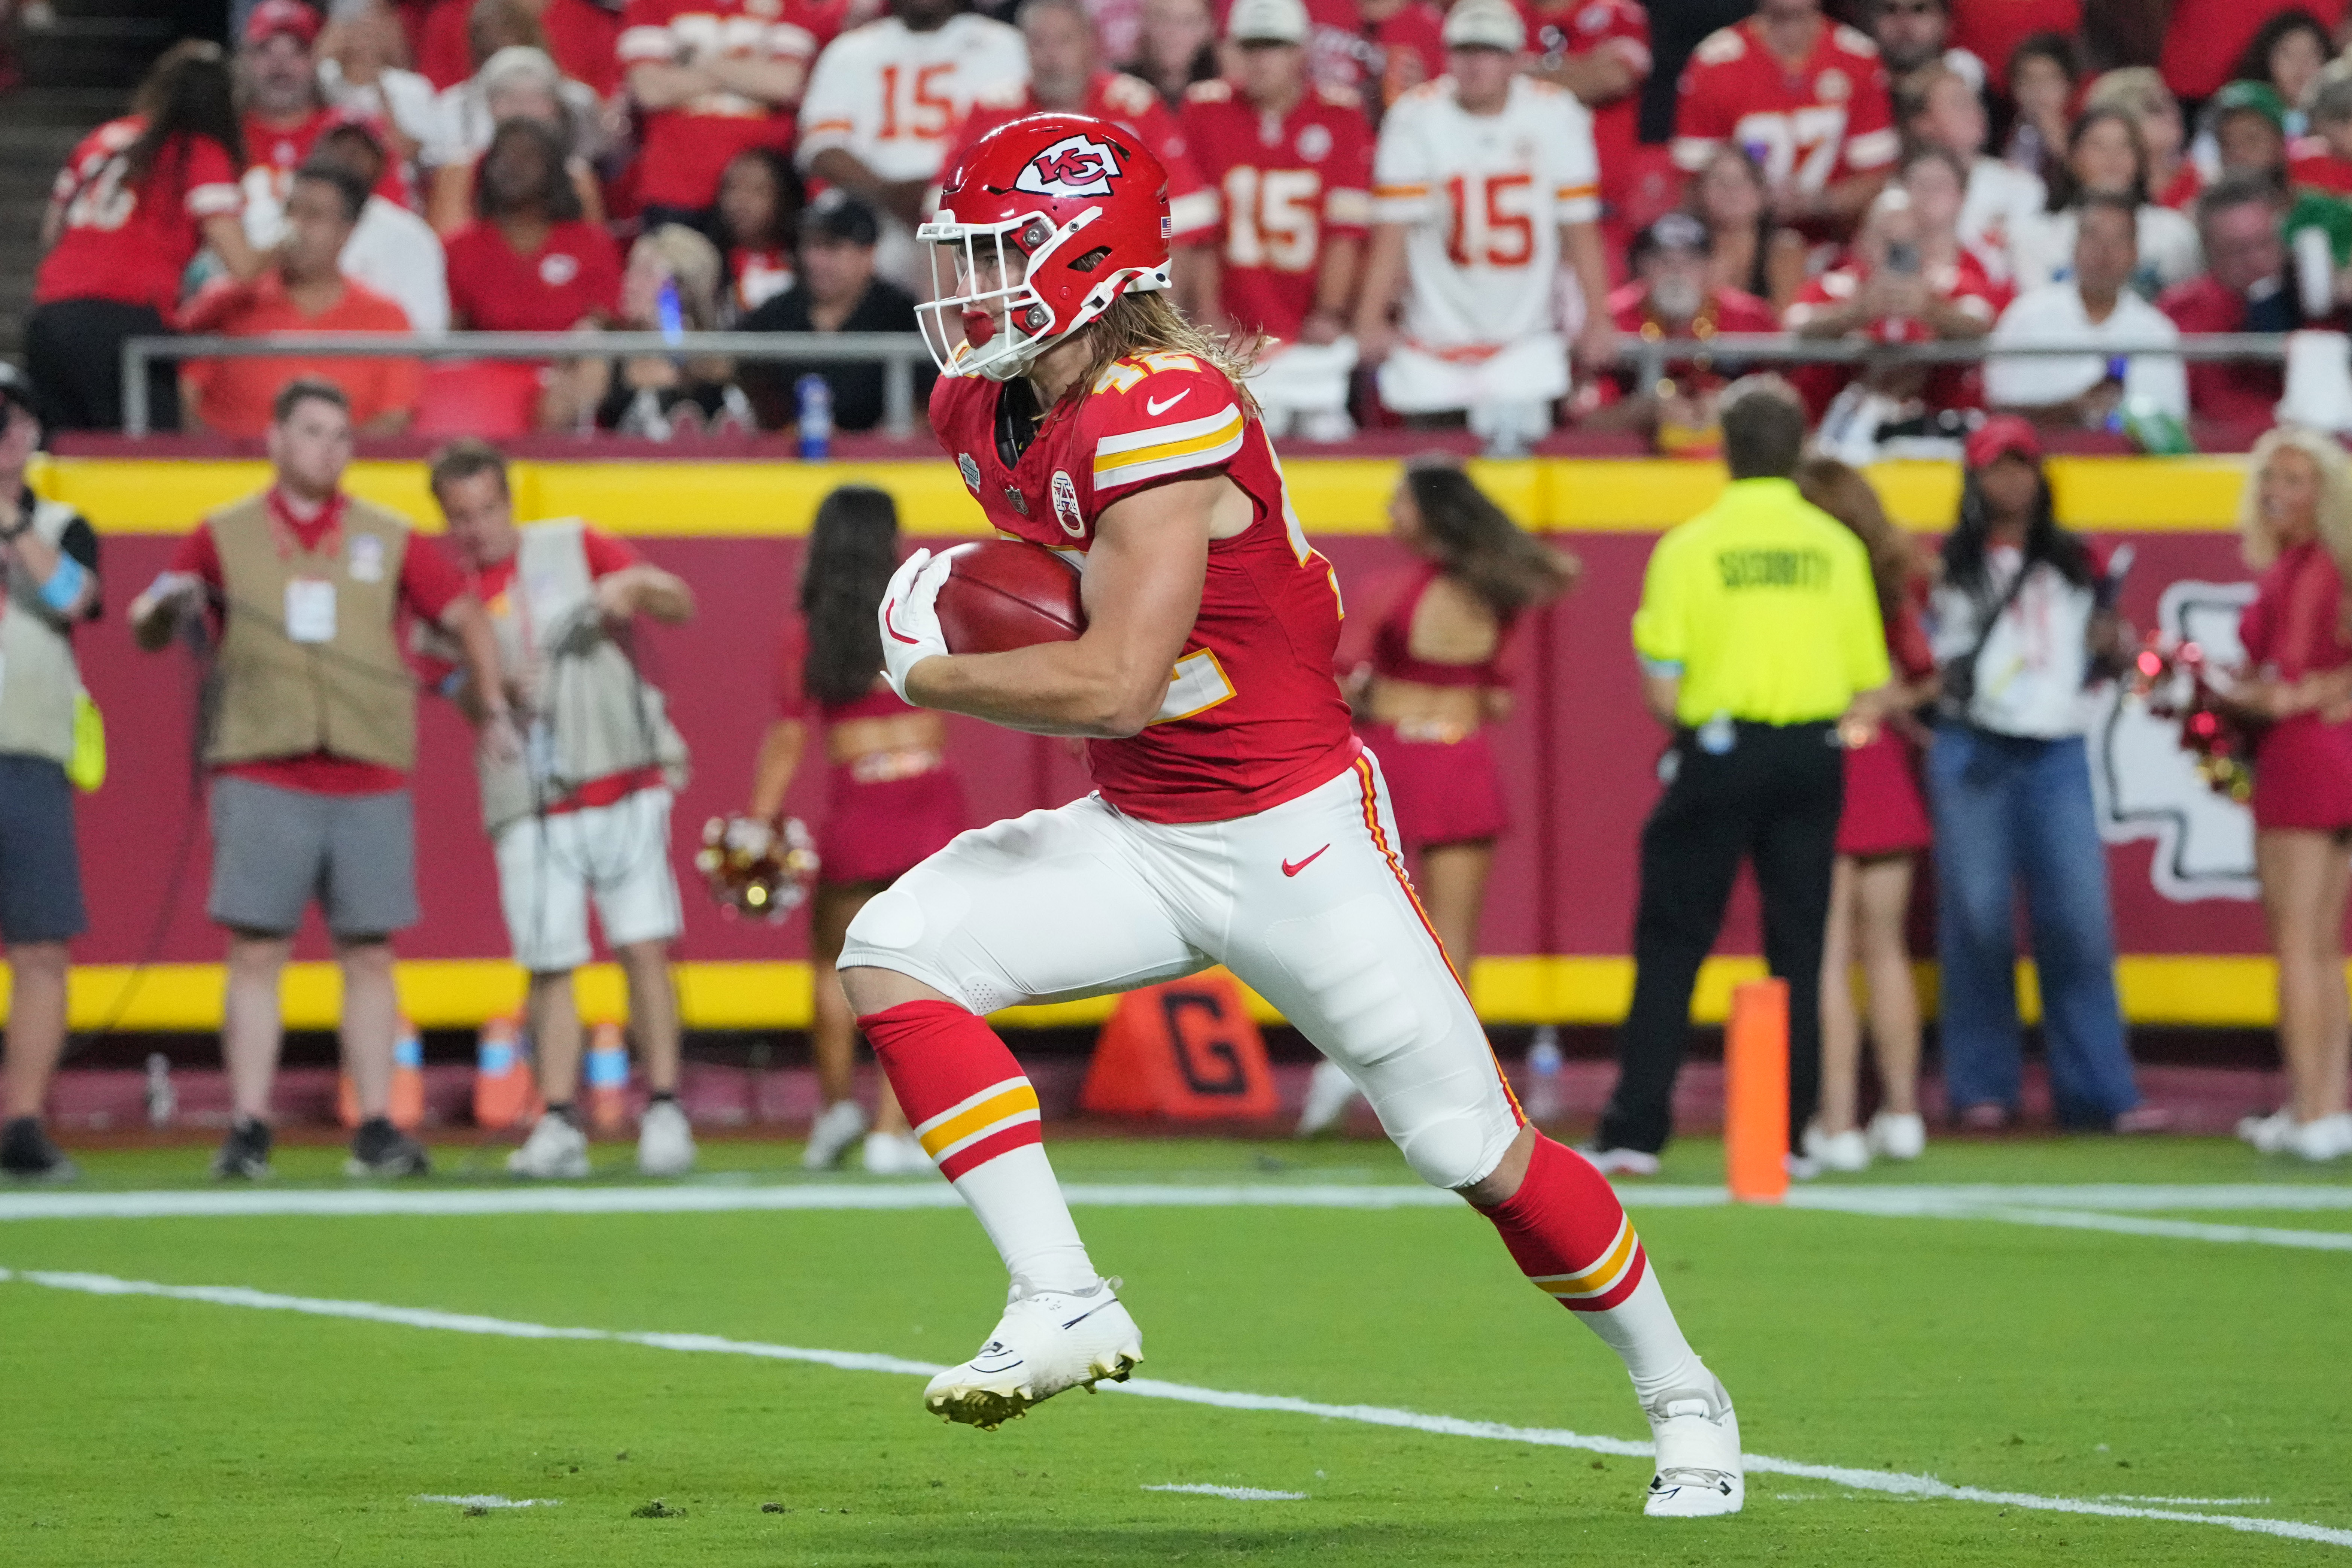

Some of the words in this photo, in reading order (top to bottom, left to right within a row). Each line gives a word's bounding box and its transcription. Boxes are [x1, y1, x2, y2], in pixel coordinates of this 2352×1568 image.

[879, 62, 958, 139] 15
[1033, 148, 1125, 186] KC
[1221, 165, 1321, 274] 15
[1445, 174, 1533, 267] 15
[1091, 347, 1202, 395] 42
[1162, 990, 1249, 1096] G
